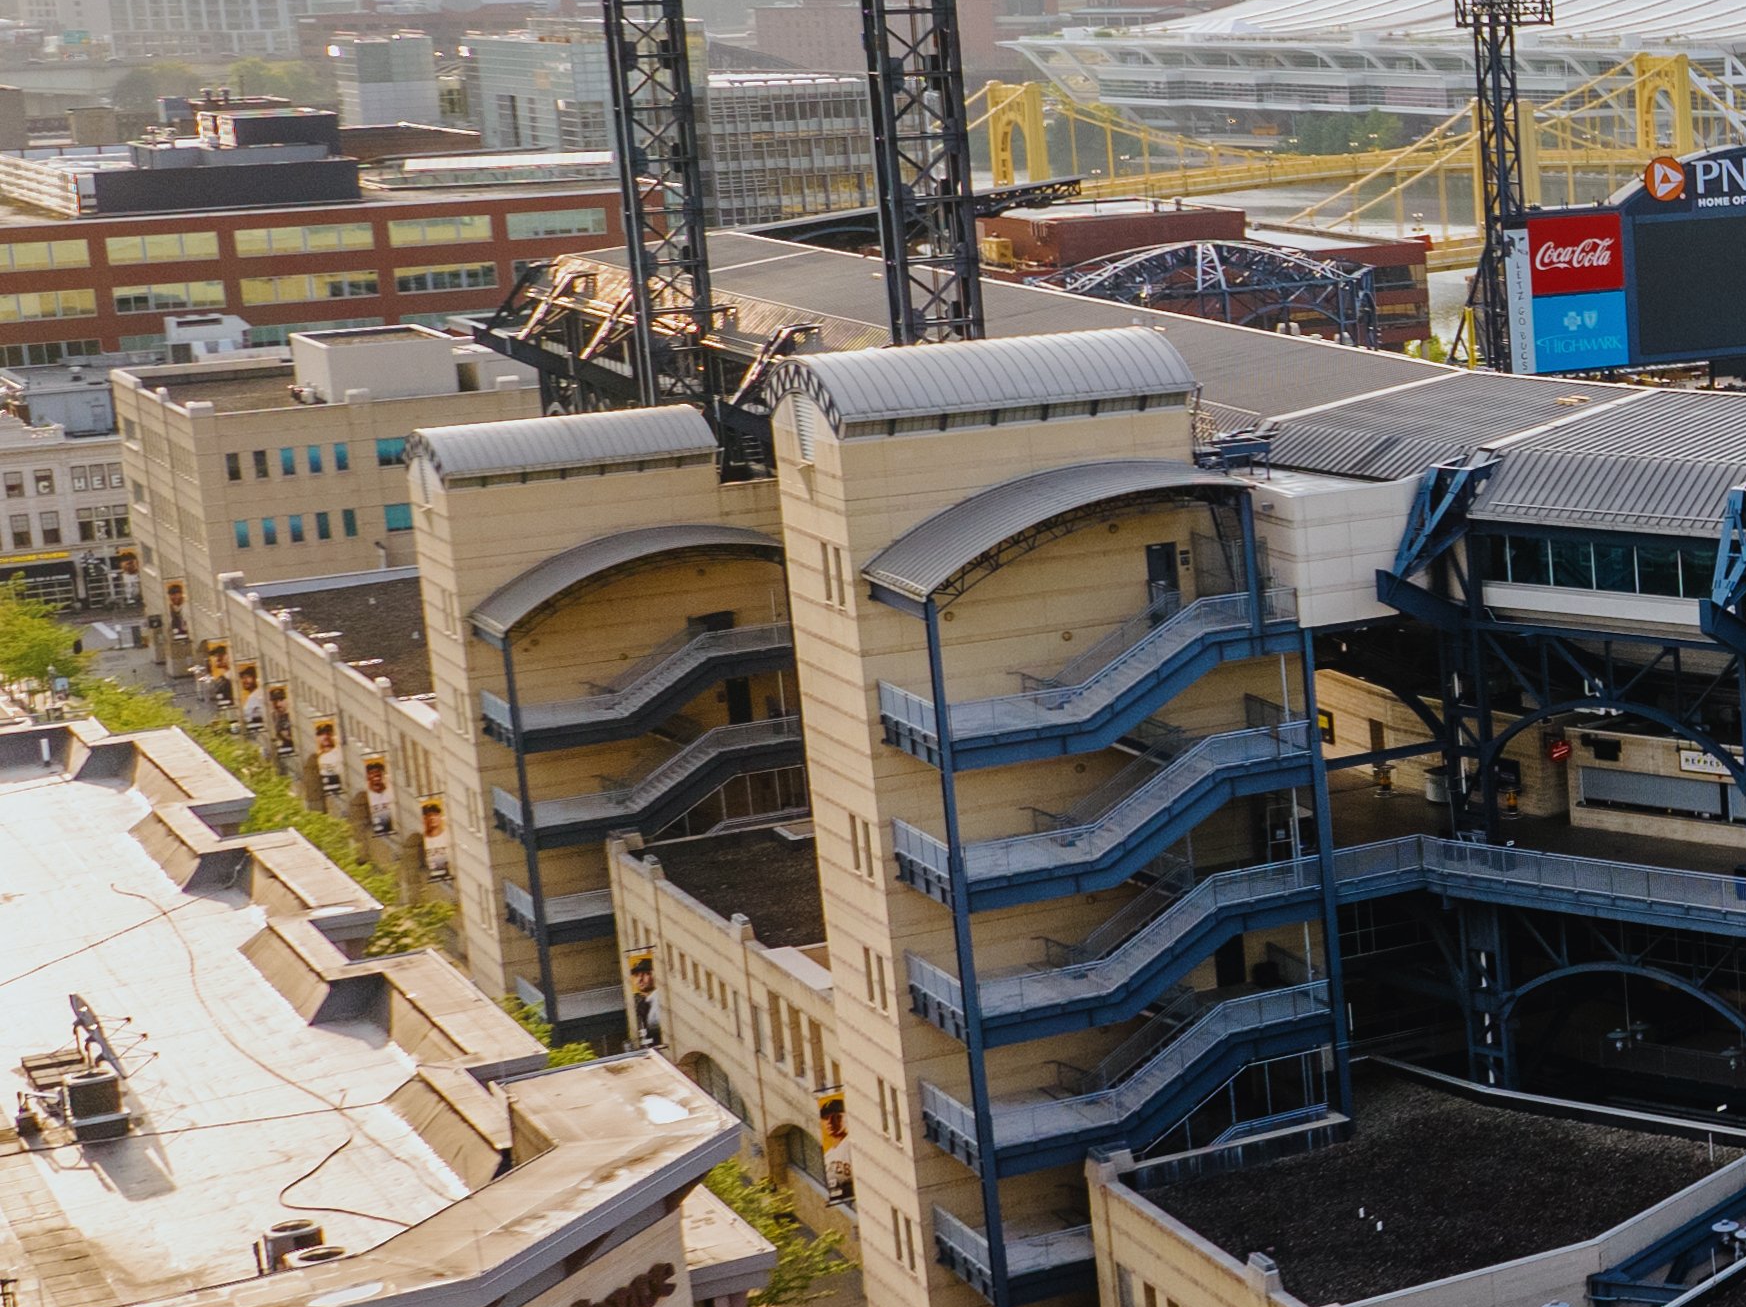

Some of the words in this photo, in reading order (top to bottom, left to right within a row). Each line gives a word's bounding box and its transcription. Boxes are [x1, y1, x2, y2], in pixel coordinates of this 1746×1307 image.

[1698, 195, 1730, 208] HOME
[1732, 194, 1746, 206] OF
[1535, 236, 1615, 271] Coca-Cola
[1540, 333, 1622, 356] HIGHMARK
